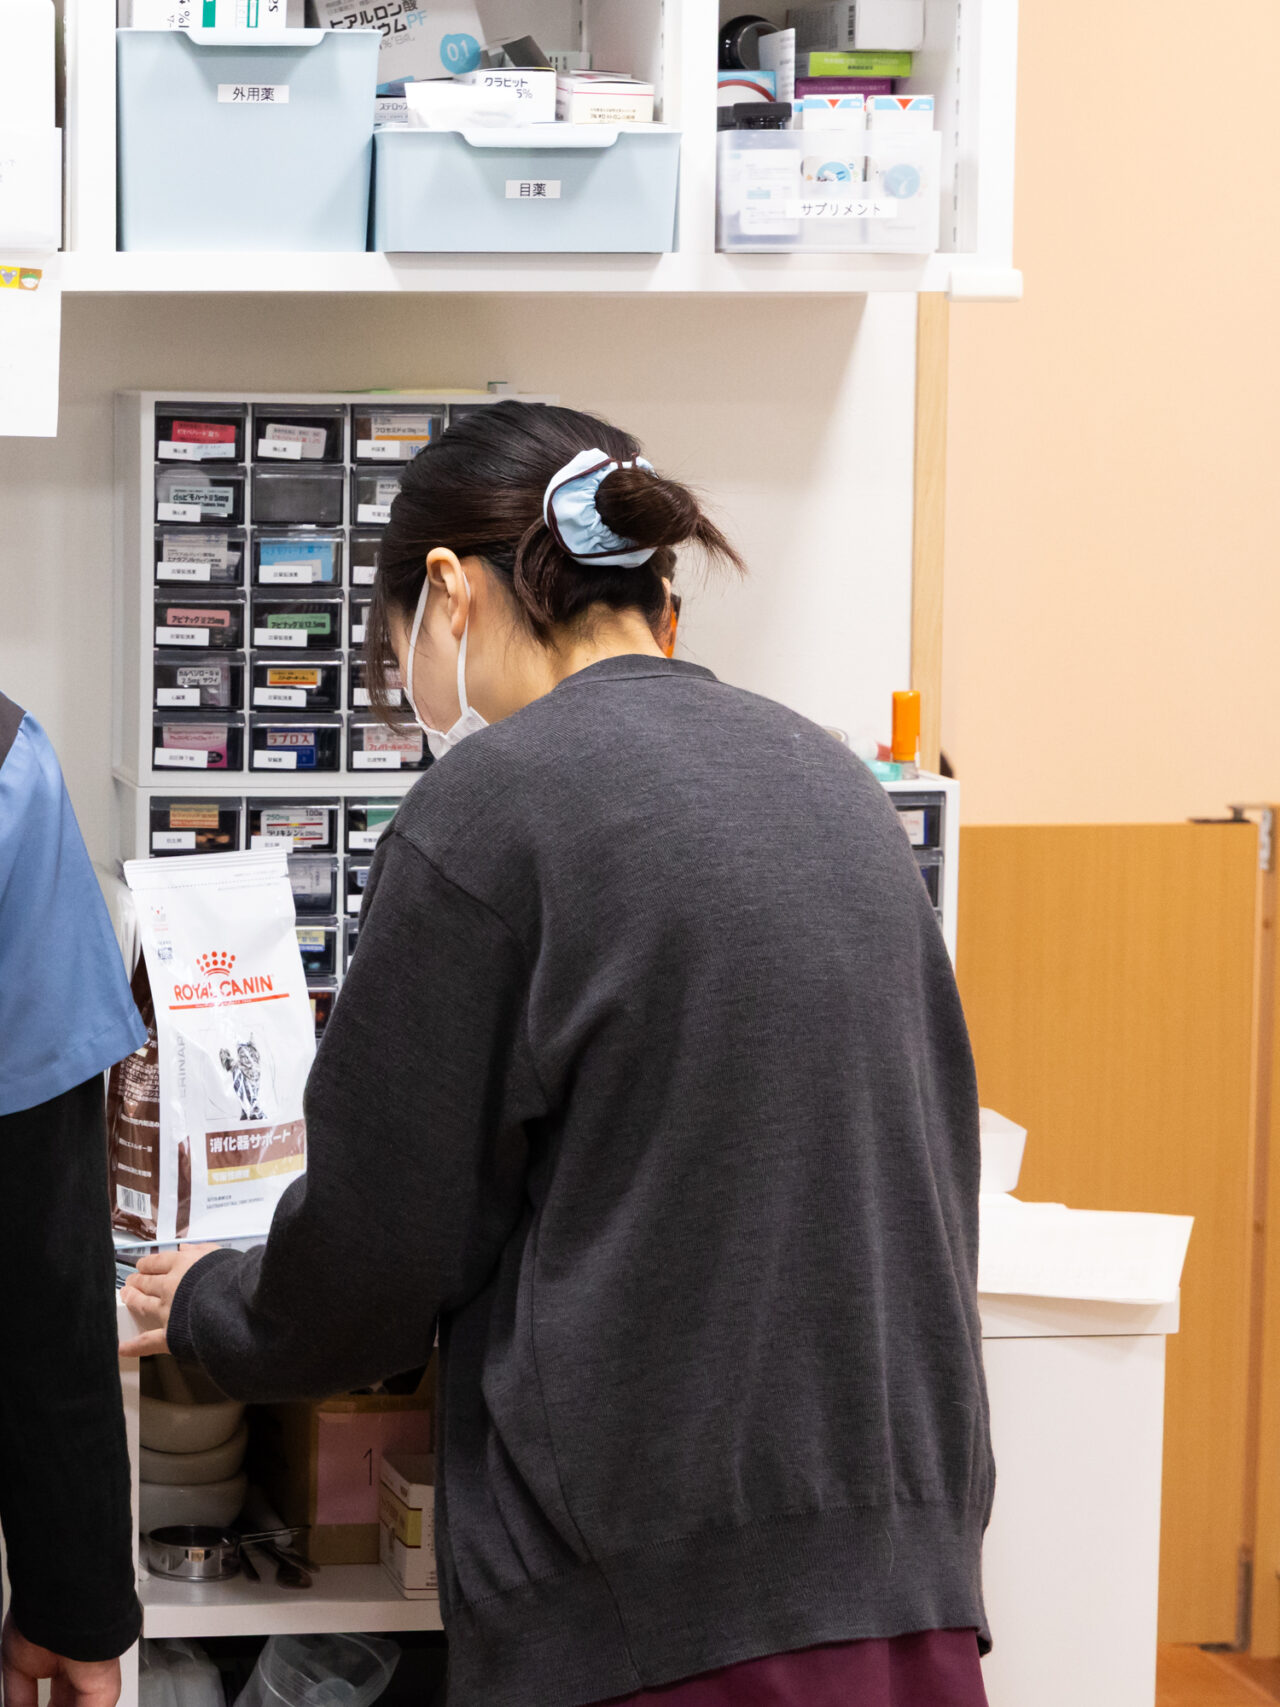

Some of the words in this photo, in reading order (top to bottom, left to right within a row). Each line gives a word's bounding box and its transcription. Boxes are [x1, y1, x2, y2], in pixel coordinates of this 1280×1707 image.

[484, 77, 528, 88] クラビット
[232, 87, 275, 102] 外用薬
[516, 89, 533, 99] 5%
[519, 183, 546, 198] 目薬
[800, 202, 881, 217] サプリメント
[220, 974, 273, 997] CANIN
[210, 1128, 292, 1153] 消化器サポート
